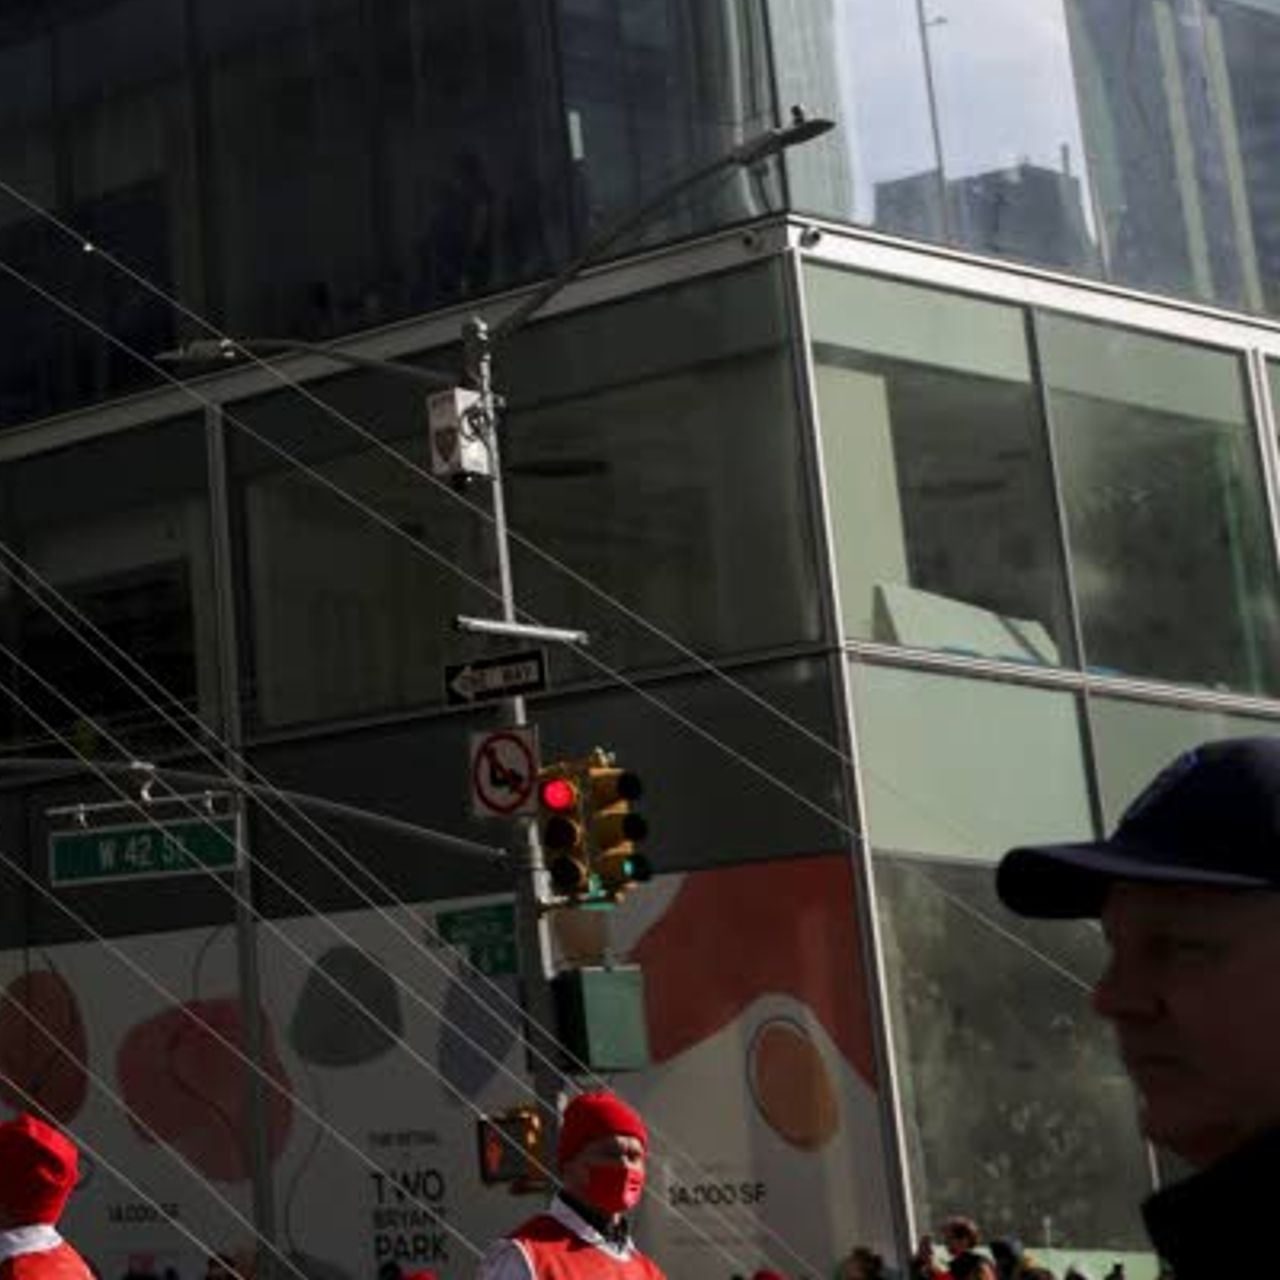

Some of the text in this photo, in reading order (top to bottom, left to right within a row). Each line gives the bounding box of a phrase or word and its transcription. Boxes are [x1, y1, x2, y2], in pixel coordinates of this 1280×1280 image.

[99, 840, 117, 870] W
[124, 834, 156, 868] 42
[370, 1166, 446, 1204] TWO
[375, 1231, 449, 1262] PARK
